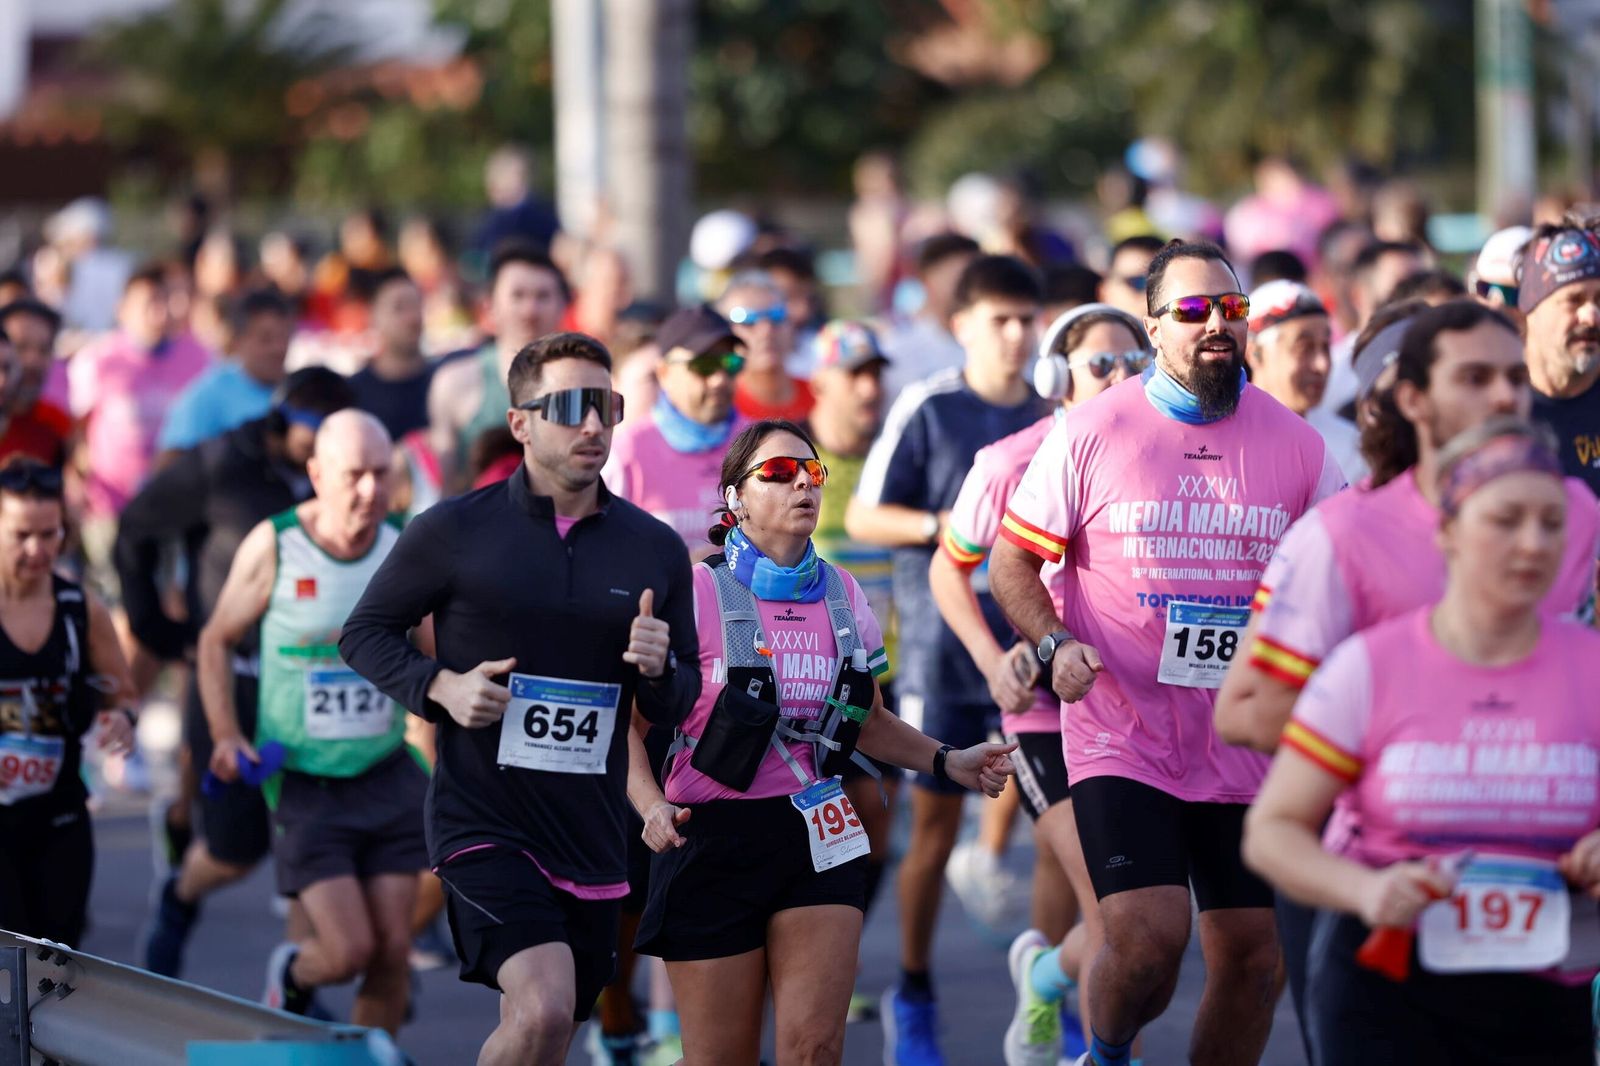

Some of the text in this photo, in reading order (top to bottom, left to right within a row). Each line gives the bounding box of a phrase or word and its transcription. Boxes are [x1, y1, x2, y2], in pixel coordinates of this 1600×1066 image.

[1177, 475, 1238, 500] XXXVI
[1108, 500, 1184, 534] MEDIA
[1122, 536, 1245, 561] INTERNACIONAL
[1148, 568, 1213, 581] INTERNATIONAL
[1215, 569, 1235, 581] HALF
[770, 630, 819, 651] XXXVI
[1173, 627, 1238, 662] 158
[780, 682, 829, 702] CIONAL
[524, 704, 599, 744] 654
[811, 797, 861, 841] 195
[1449, 890, 1546, 933] 197
